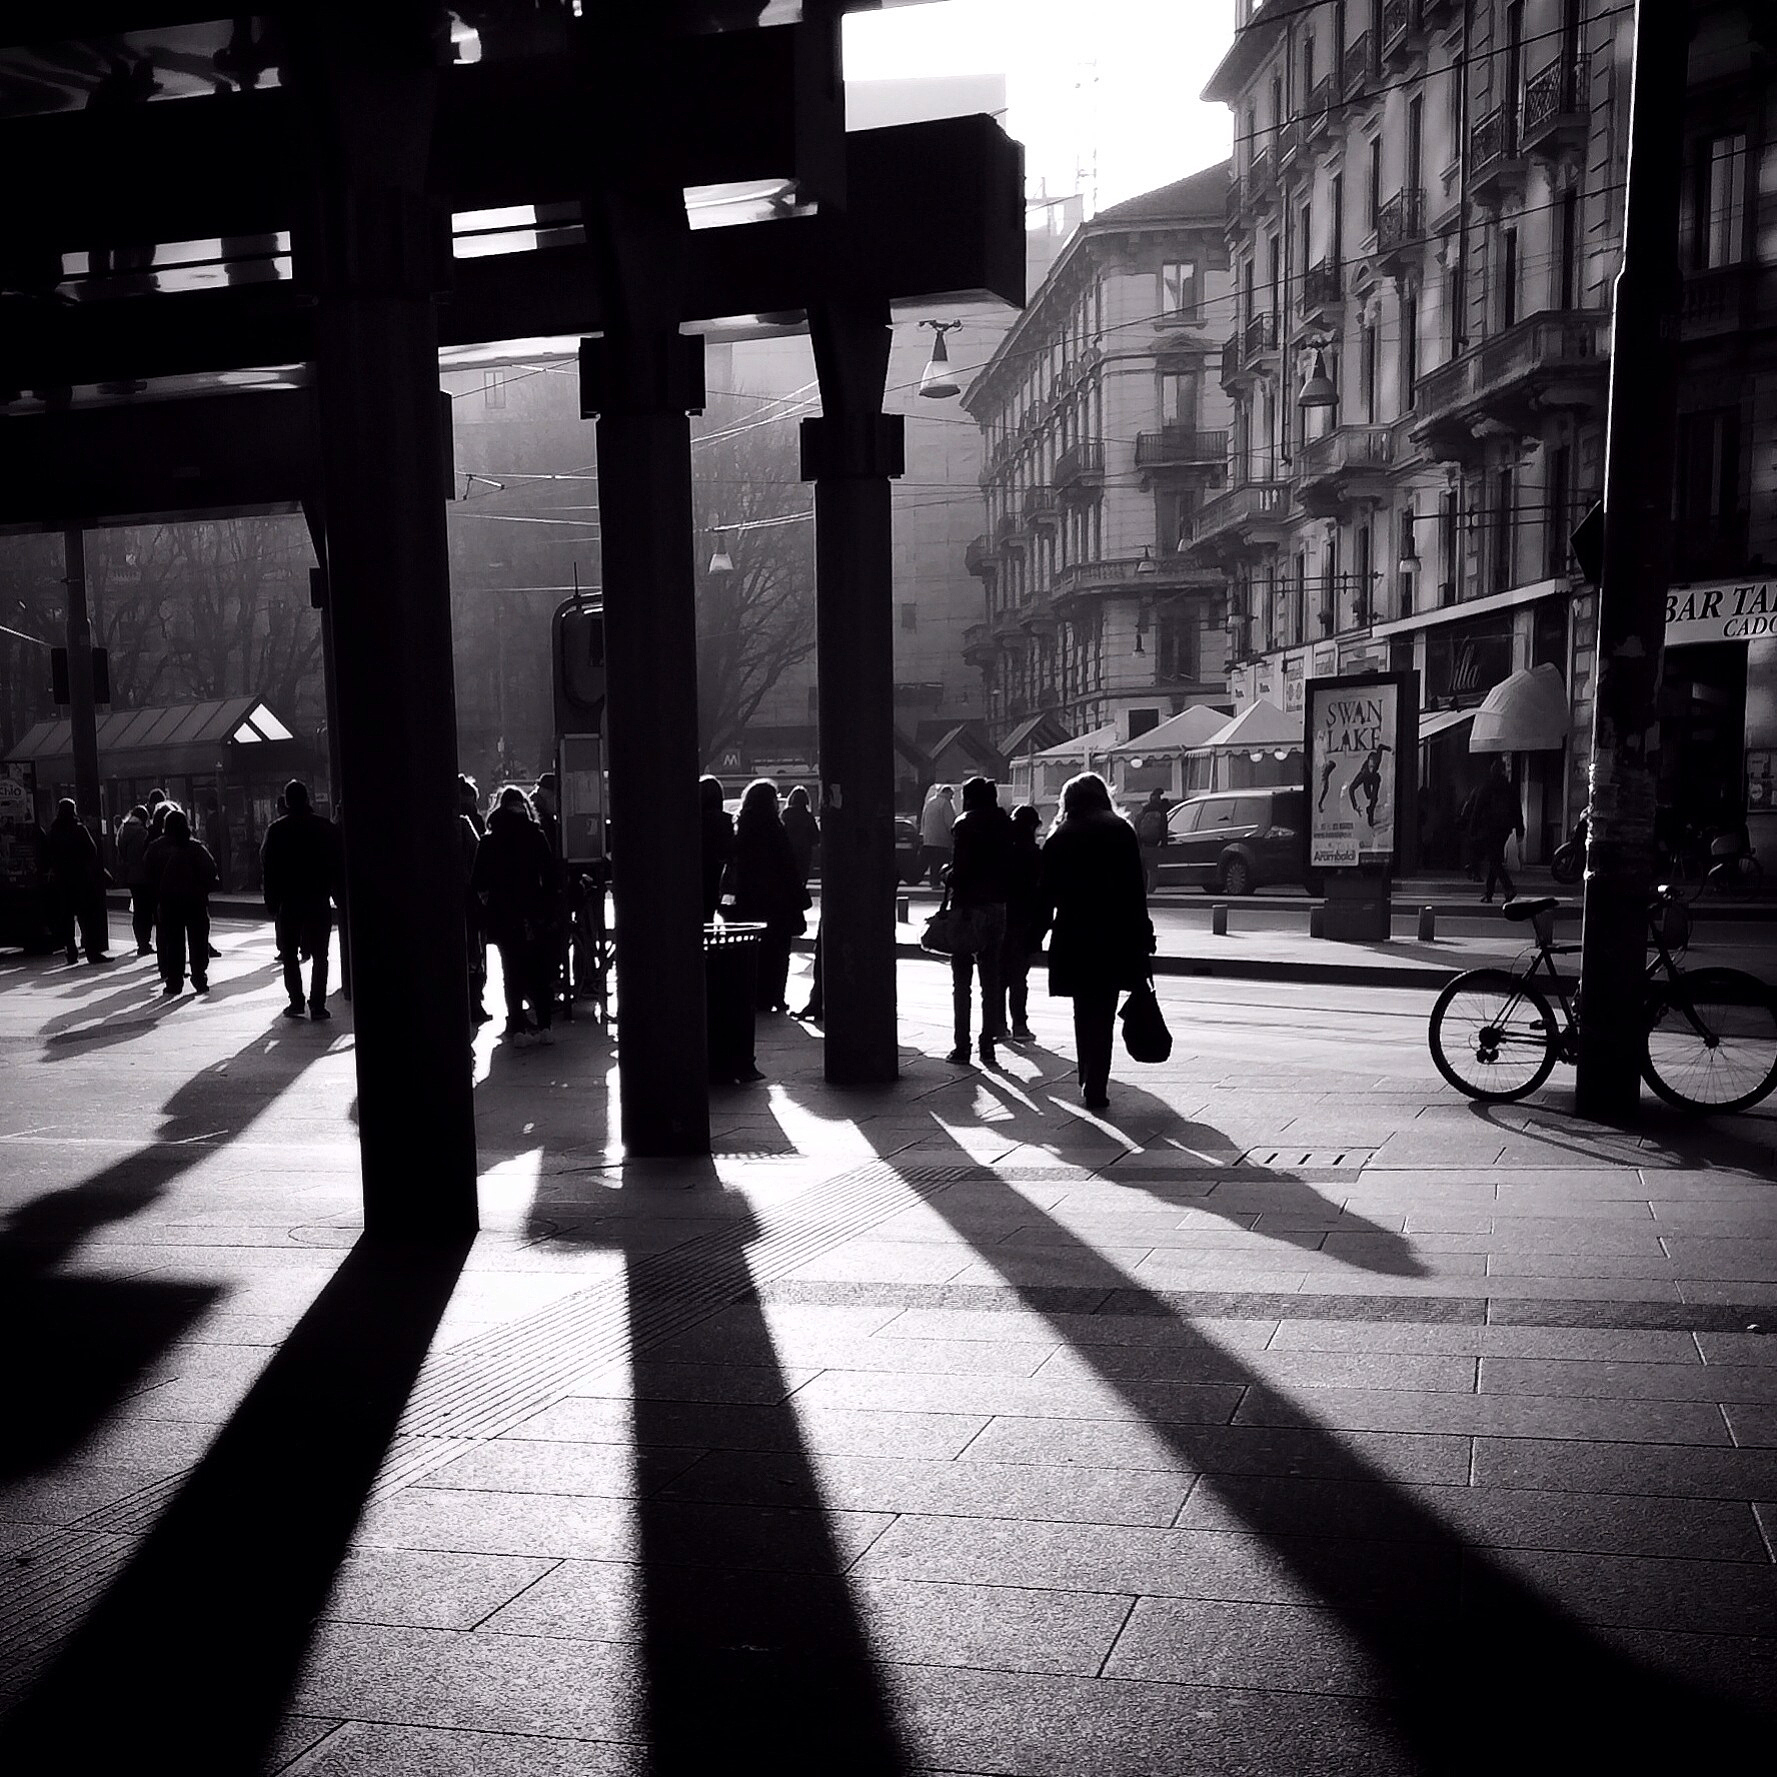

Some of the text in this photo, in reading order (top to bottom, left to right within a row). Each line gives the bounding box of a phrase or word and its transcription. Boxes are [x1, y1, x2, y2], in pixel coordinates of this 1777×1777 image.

[1665, 590, 1724, 623] BAR
[1326, 699, 1382, 732] SWAN
[1326, 727, 1381, 753] LAKE
